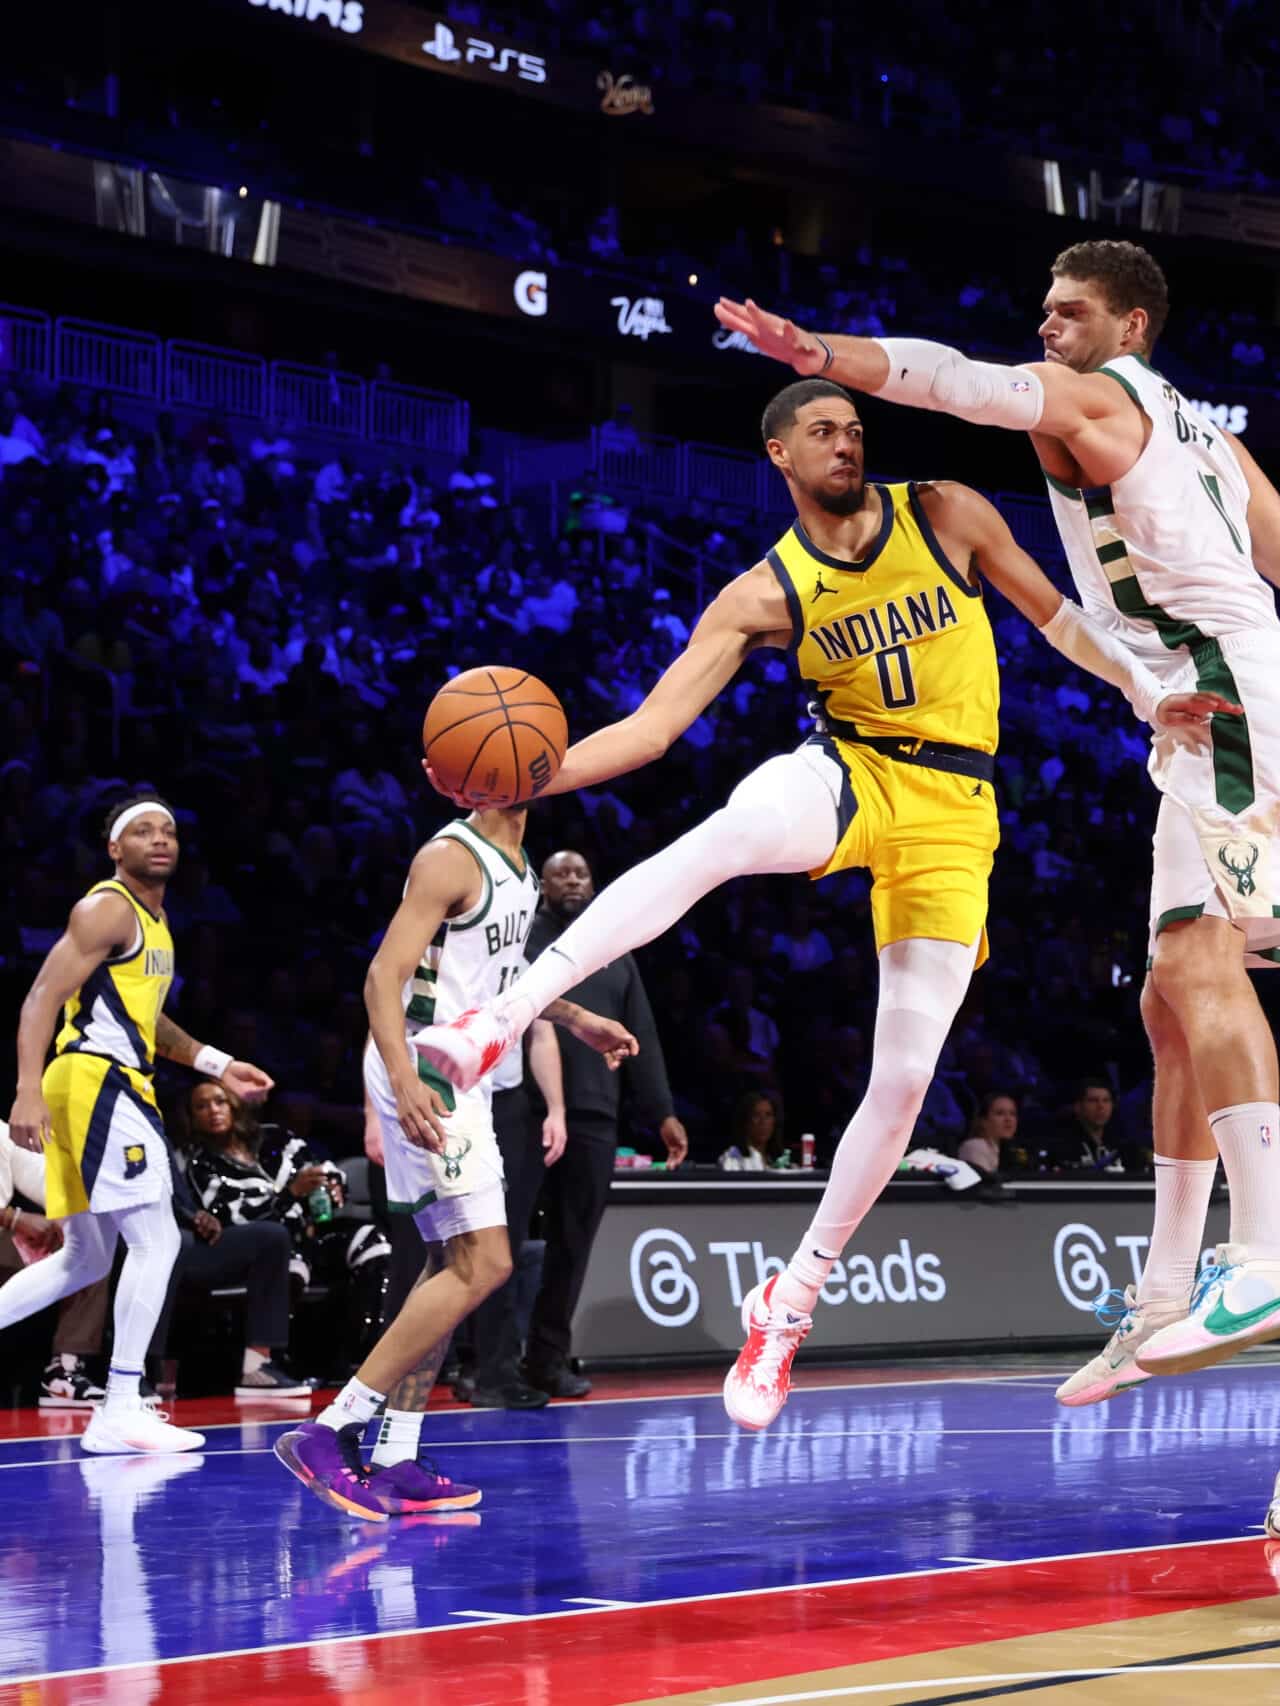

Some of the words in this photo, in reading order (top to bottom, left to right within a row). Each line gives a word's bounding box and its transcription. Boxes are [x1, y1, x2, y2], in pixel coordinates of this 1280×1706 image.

[466, 37, 547, 83] PS5
[809, 585, 958, 662] INDIANA
[873, 643, 918, 710] 0
[708, 1239, 947, 1307] Theads
